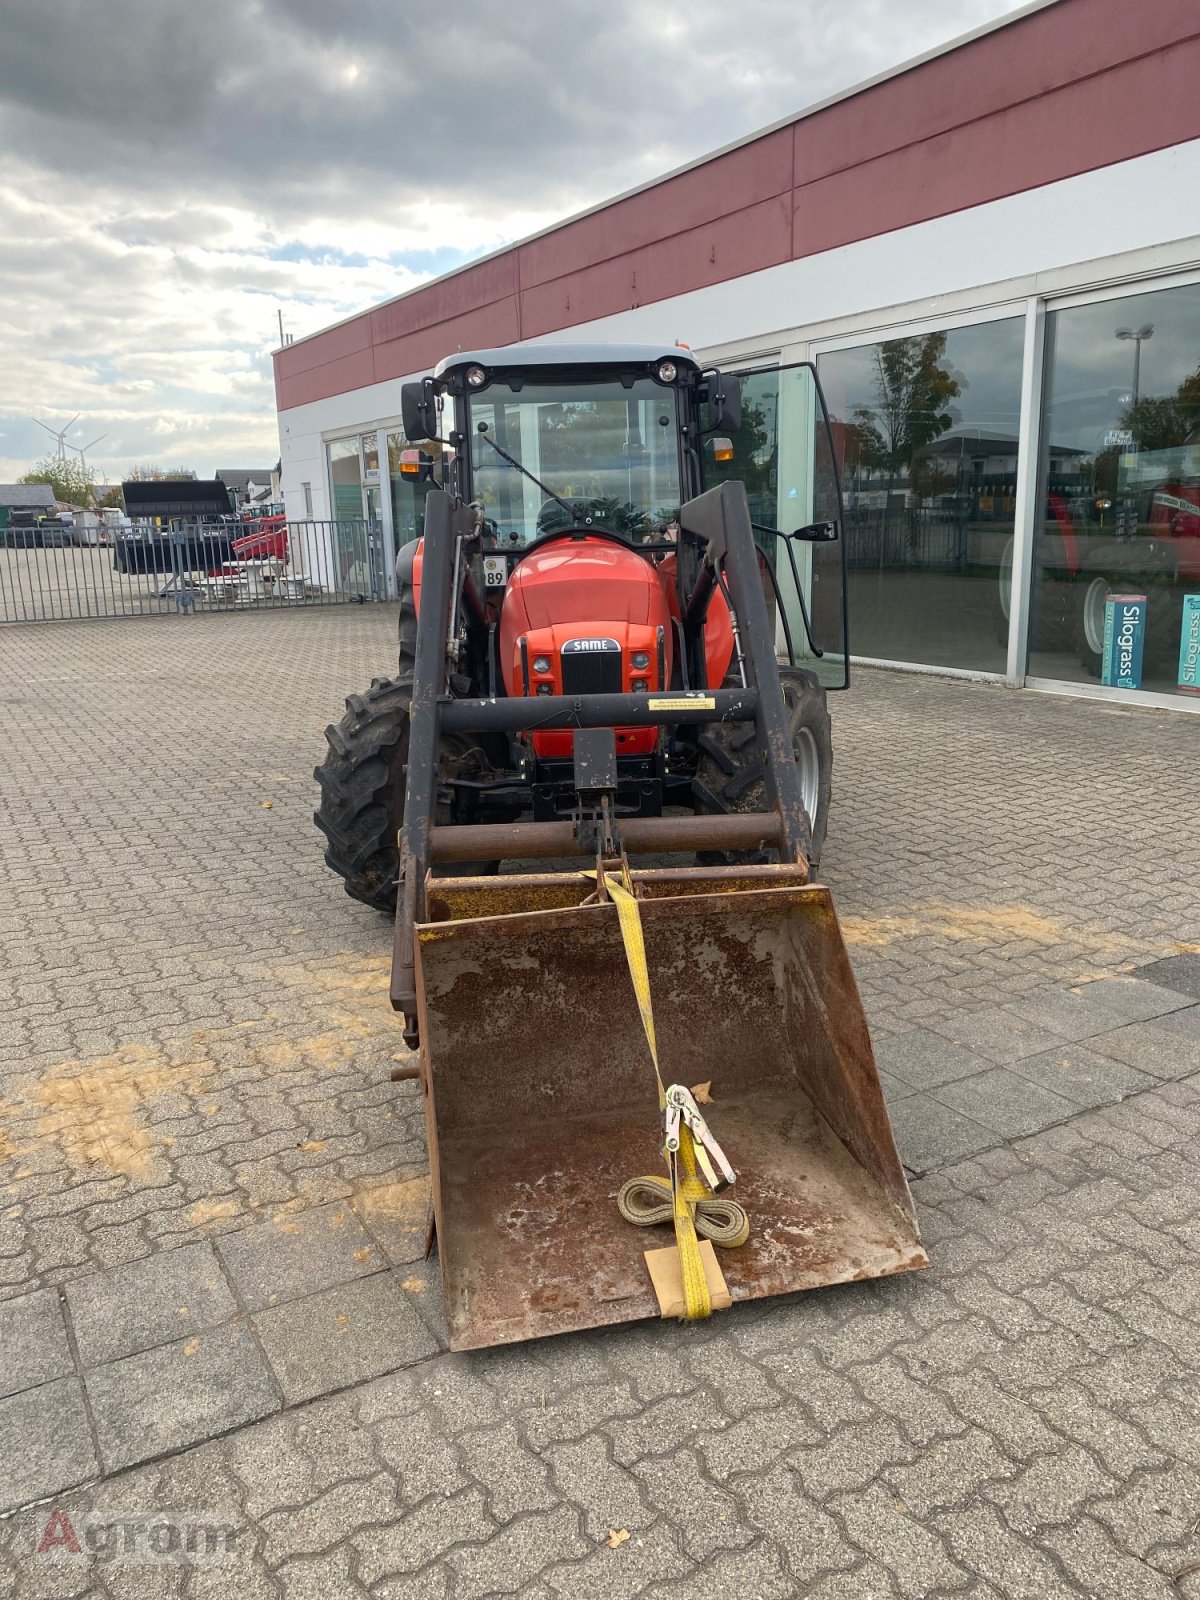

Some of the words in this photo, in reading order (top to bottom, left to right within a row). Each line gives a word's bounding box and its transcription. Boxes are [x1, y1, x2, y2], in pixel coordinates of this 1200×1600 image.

[487, 572, 503, 585] 89
[573, 640, 608, 651] SAME
[1117, 606, 1140, 676] Silograss
[1183, 612, 1200, 683] Silograss
